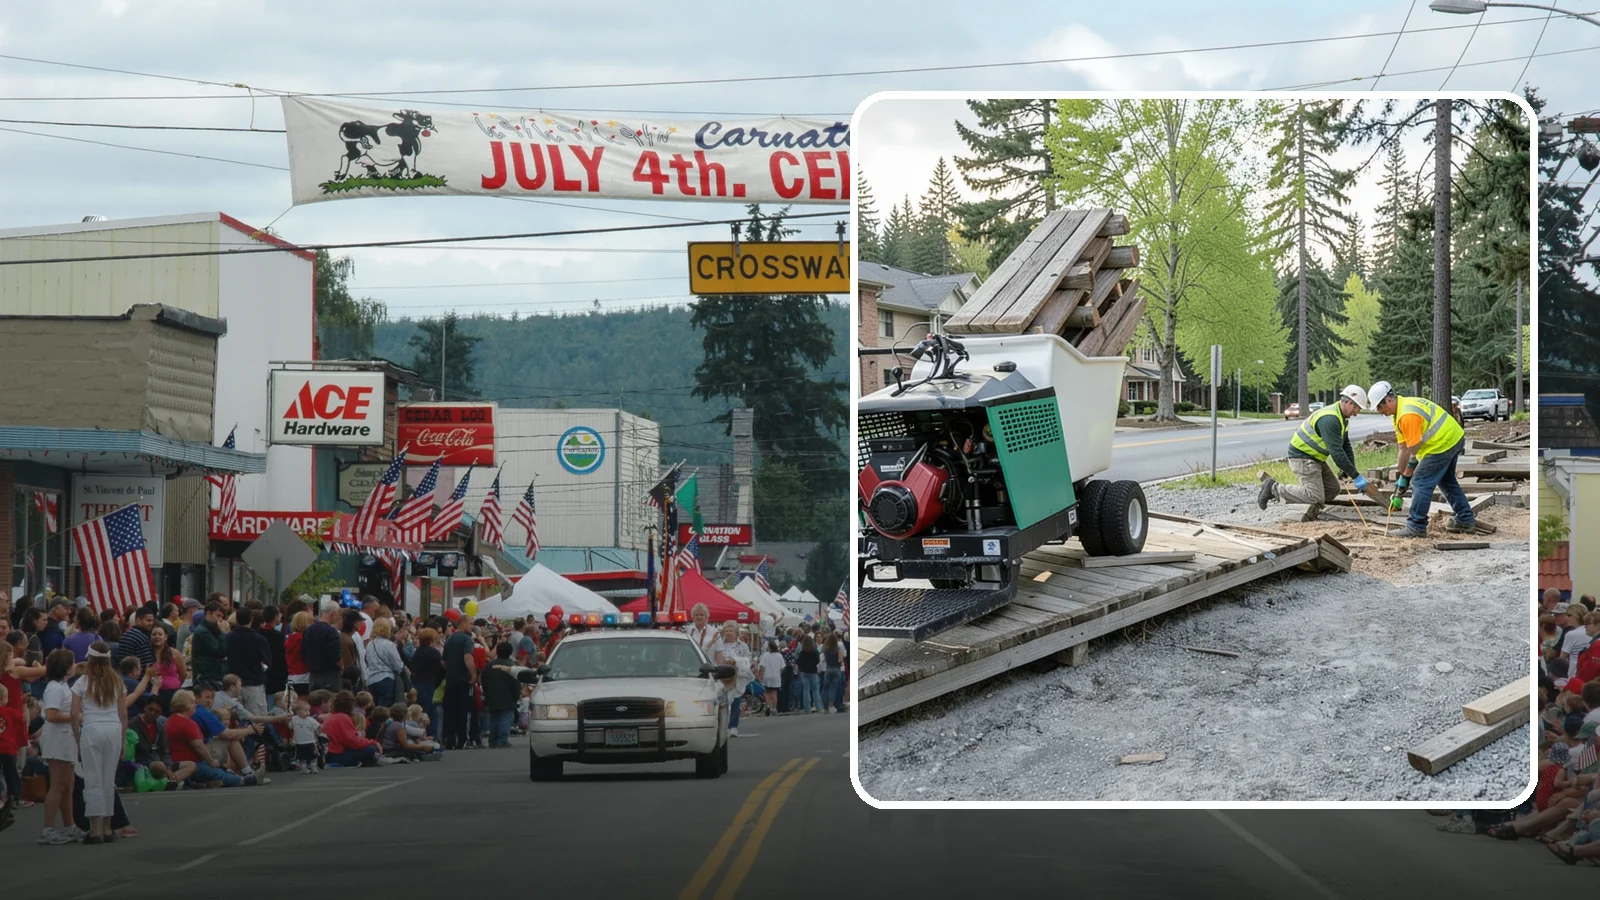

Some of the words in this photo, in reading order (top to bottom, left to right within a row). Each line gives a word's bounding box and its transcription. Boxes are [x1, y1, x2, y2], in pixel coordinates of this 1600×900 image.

[481, 141, 605, 192] JULY
[632, 150, 746, 198] 4th.
[697, 254, 850, 280] CROSSWA
[283, 380, 373, 420] ACE
[405, 409, 452, 422] CEDAR
[284, 421, 371, 437] Hardware
[416, 428, 477, 447] Coca-Cola
[353, 467, 385, 479] Simpl
[83, 485, 93, 494] St.
[95, 485, 124, 494] Vincent
[126, 486, 135, 494] de
[138, 486, 155, 495] Paul
[212, 516, 331, 535] HARDARE
[688, 526, 741, 535] CRNATION
[699, 535, 730, 543] GLASS
